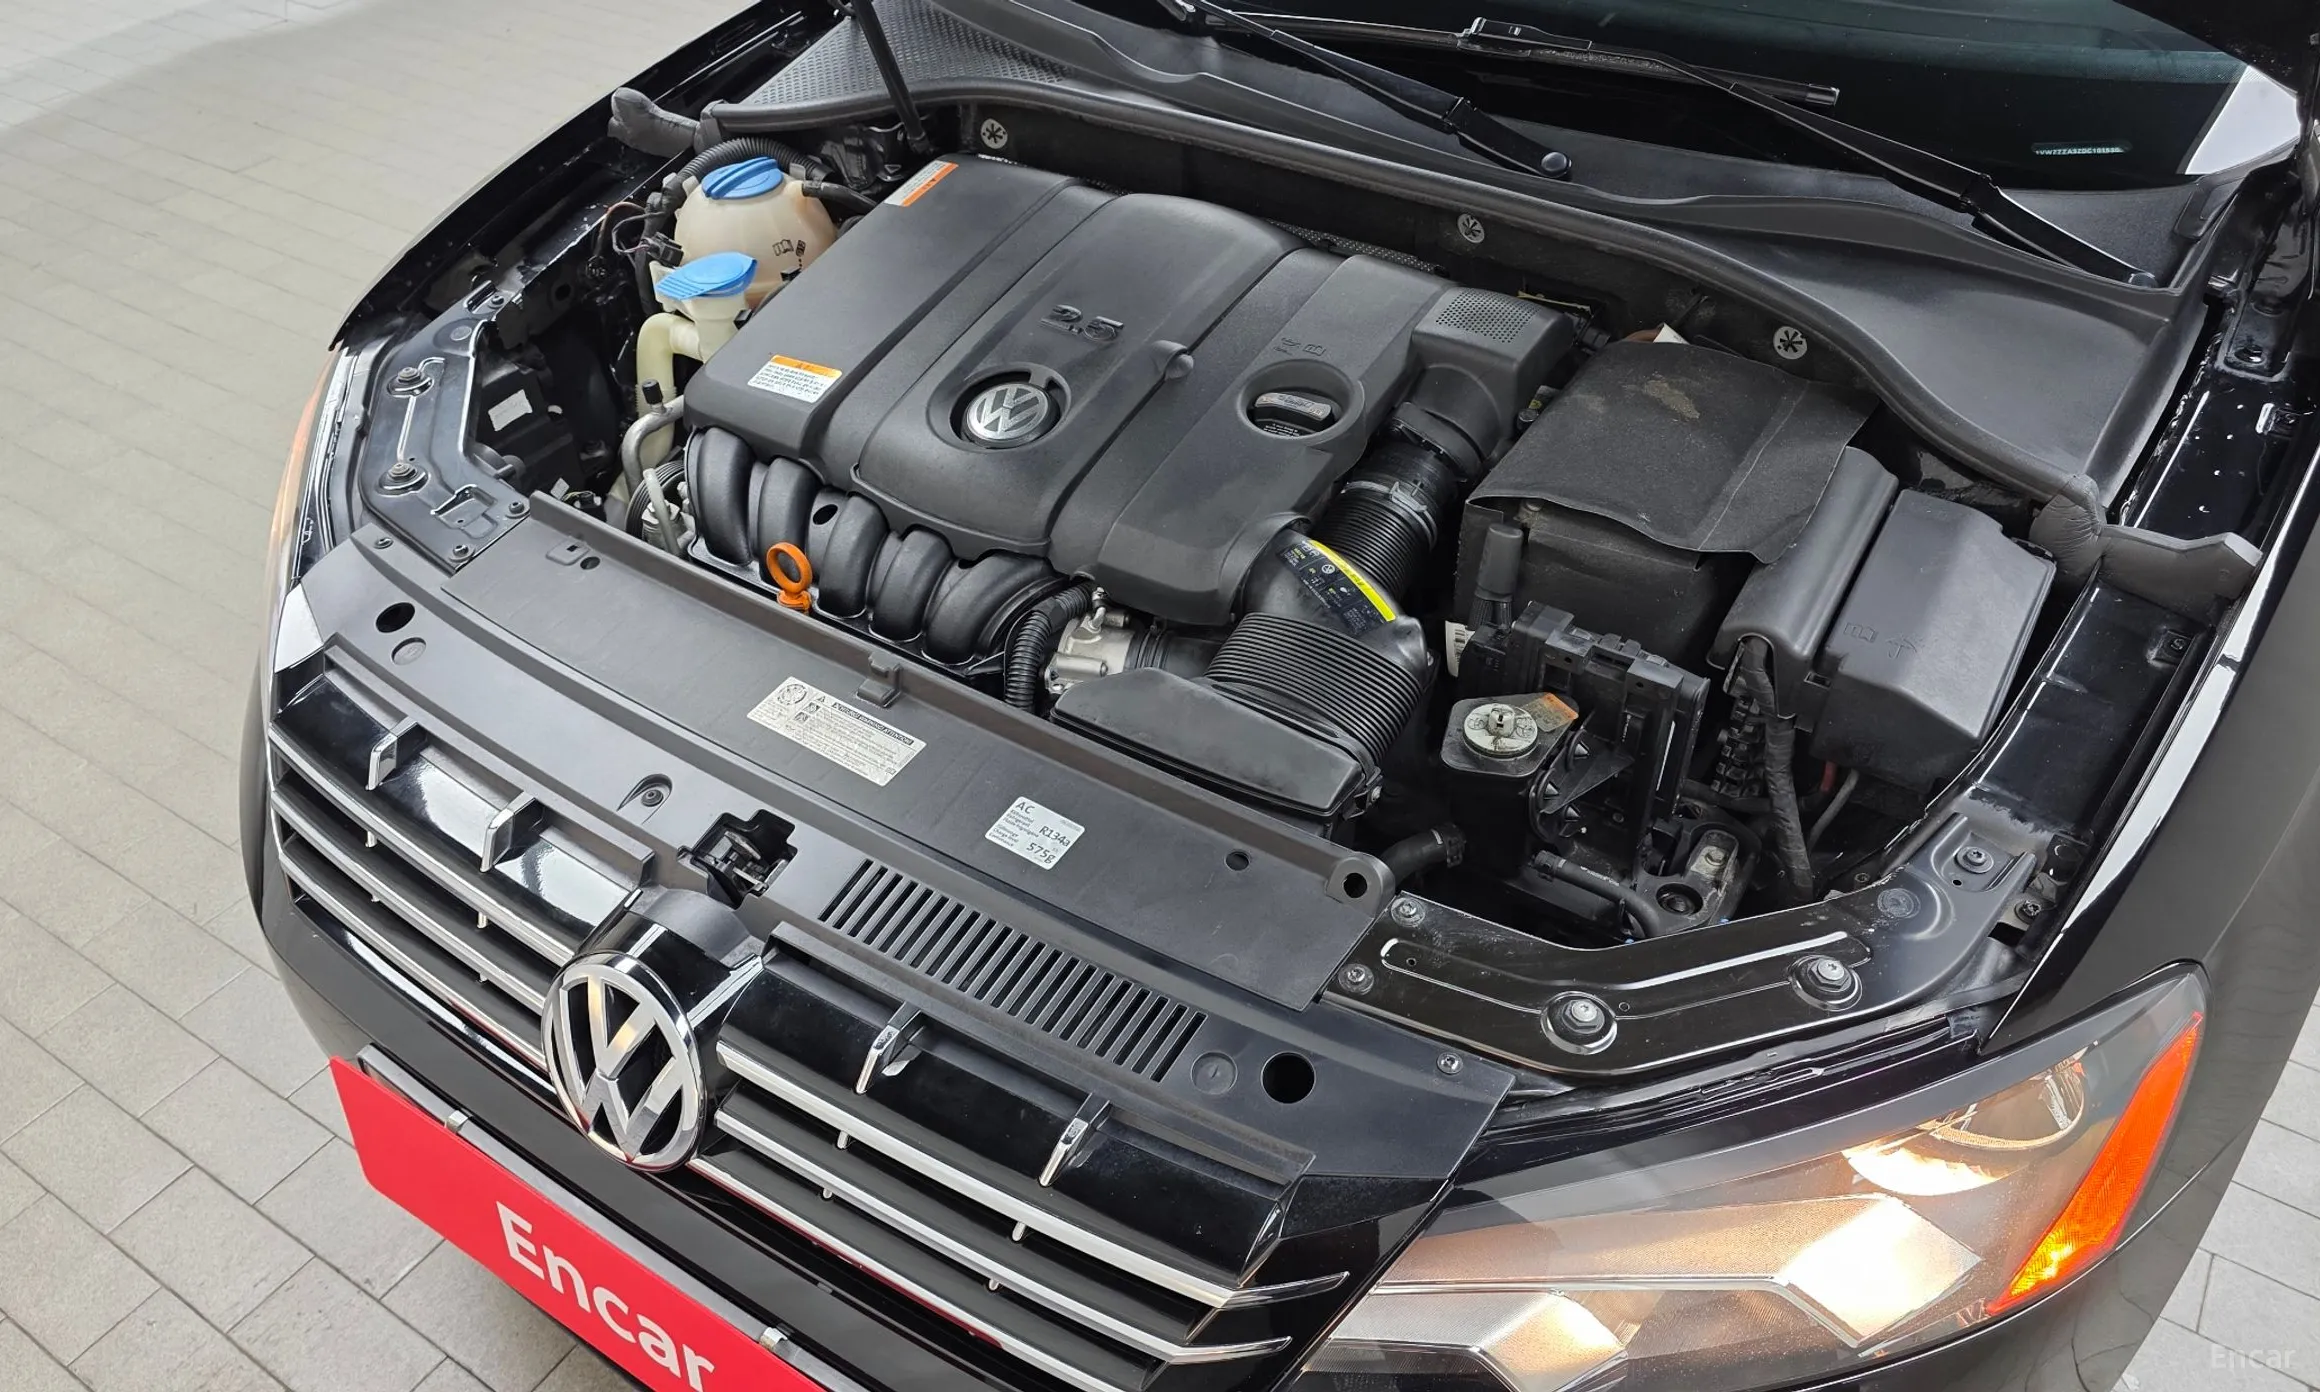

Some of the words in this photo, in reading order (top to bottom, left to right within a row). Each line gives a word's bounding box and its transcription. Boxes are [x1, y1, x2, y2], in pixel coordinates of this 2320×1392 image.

[1041, 304, 1124, 342] 2.5
[1015, 801, 1035, 814] AC
[1039, 826, 1070, 846] R134a
[1026, 843, 1055, 863] 575g
[496, 1200, 715, 1392] Encar
